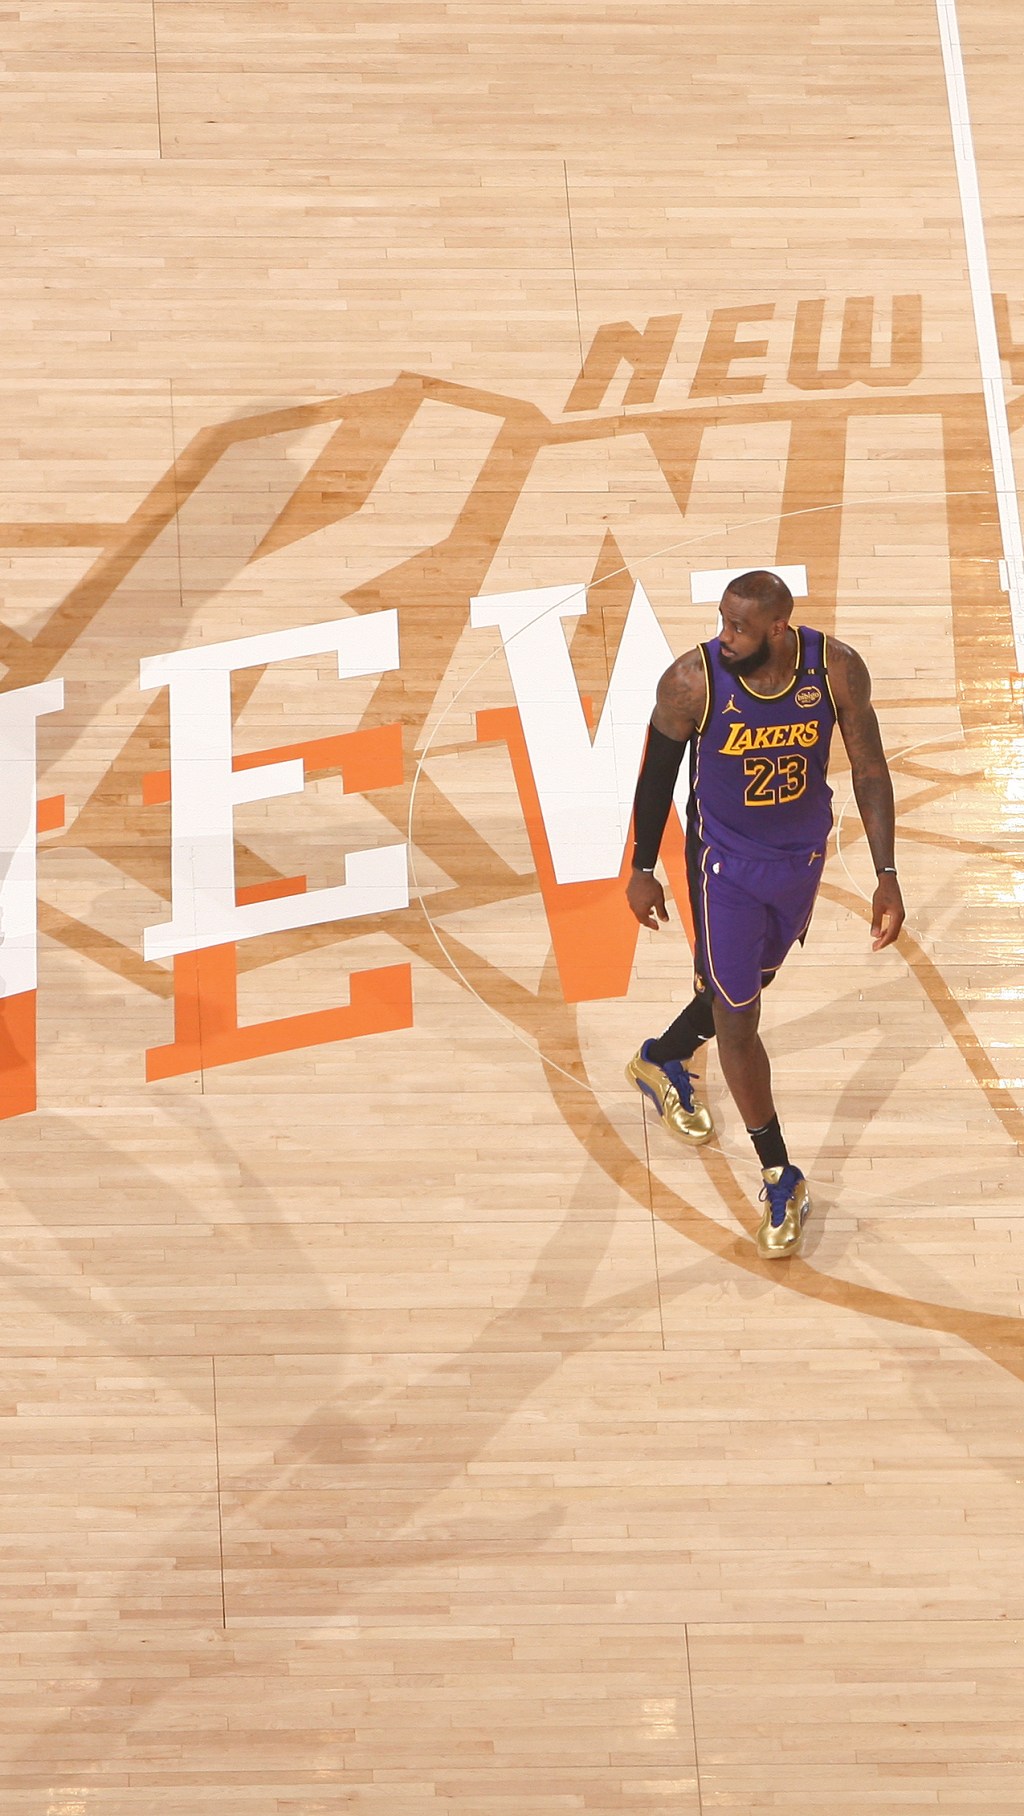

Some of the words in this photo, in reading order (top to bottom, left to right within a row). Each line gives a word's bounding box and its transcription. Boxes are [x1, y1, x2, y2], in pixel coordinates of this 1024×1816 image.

[562, 294, 922, 412] NEW
[718, 720, 820, 756] LAKERS
[743, 754, 808, 807] 23
[0, 563, 808, 1000] EW
